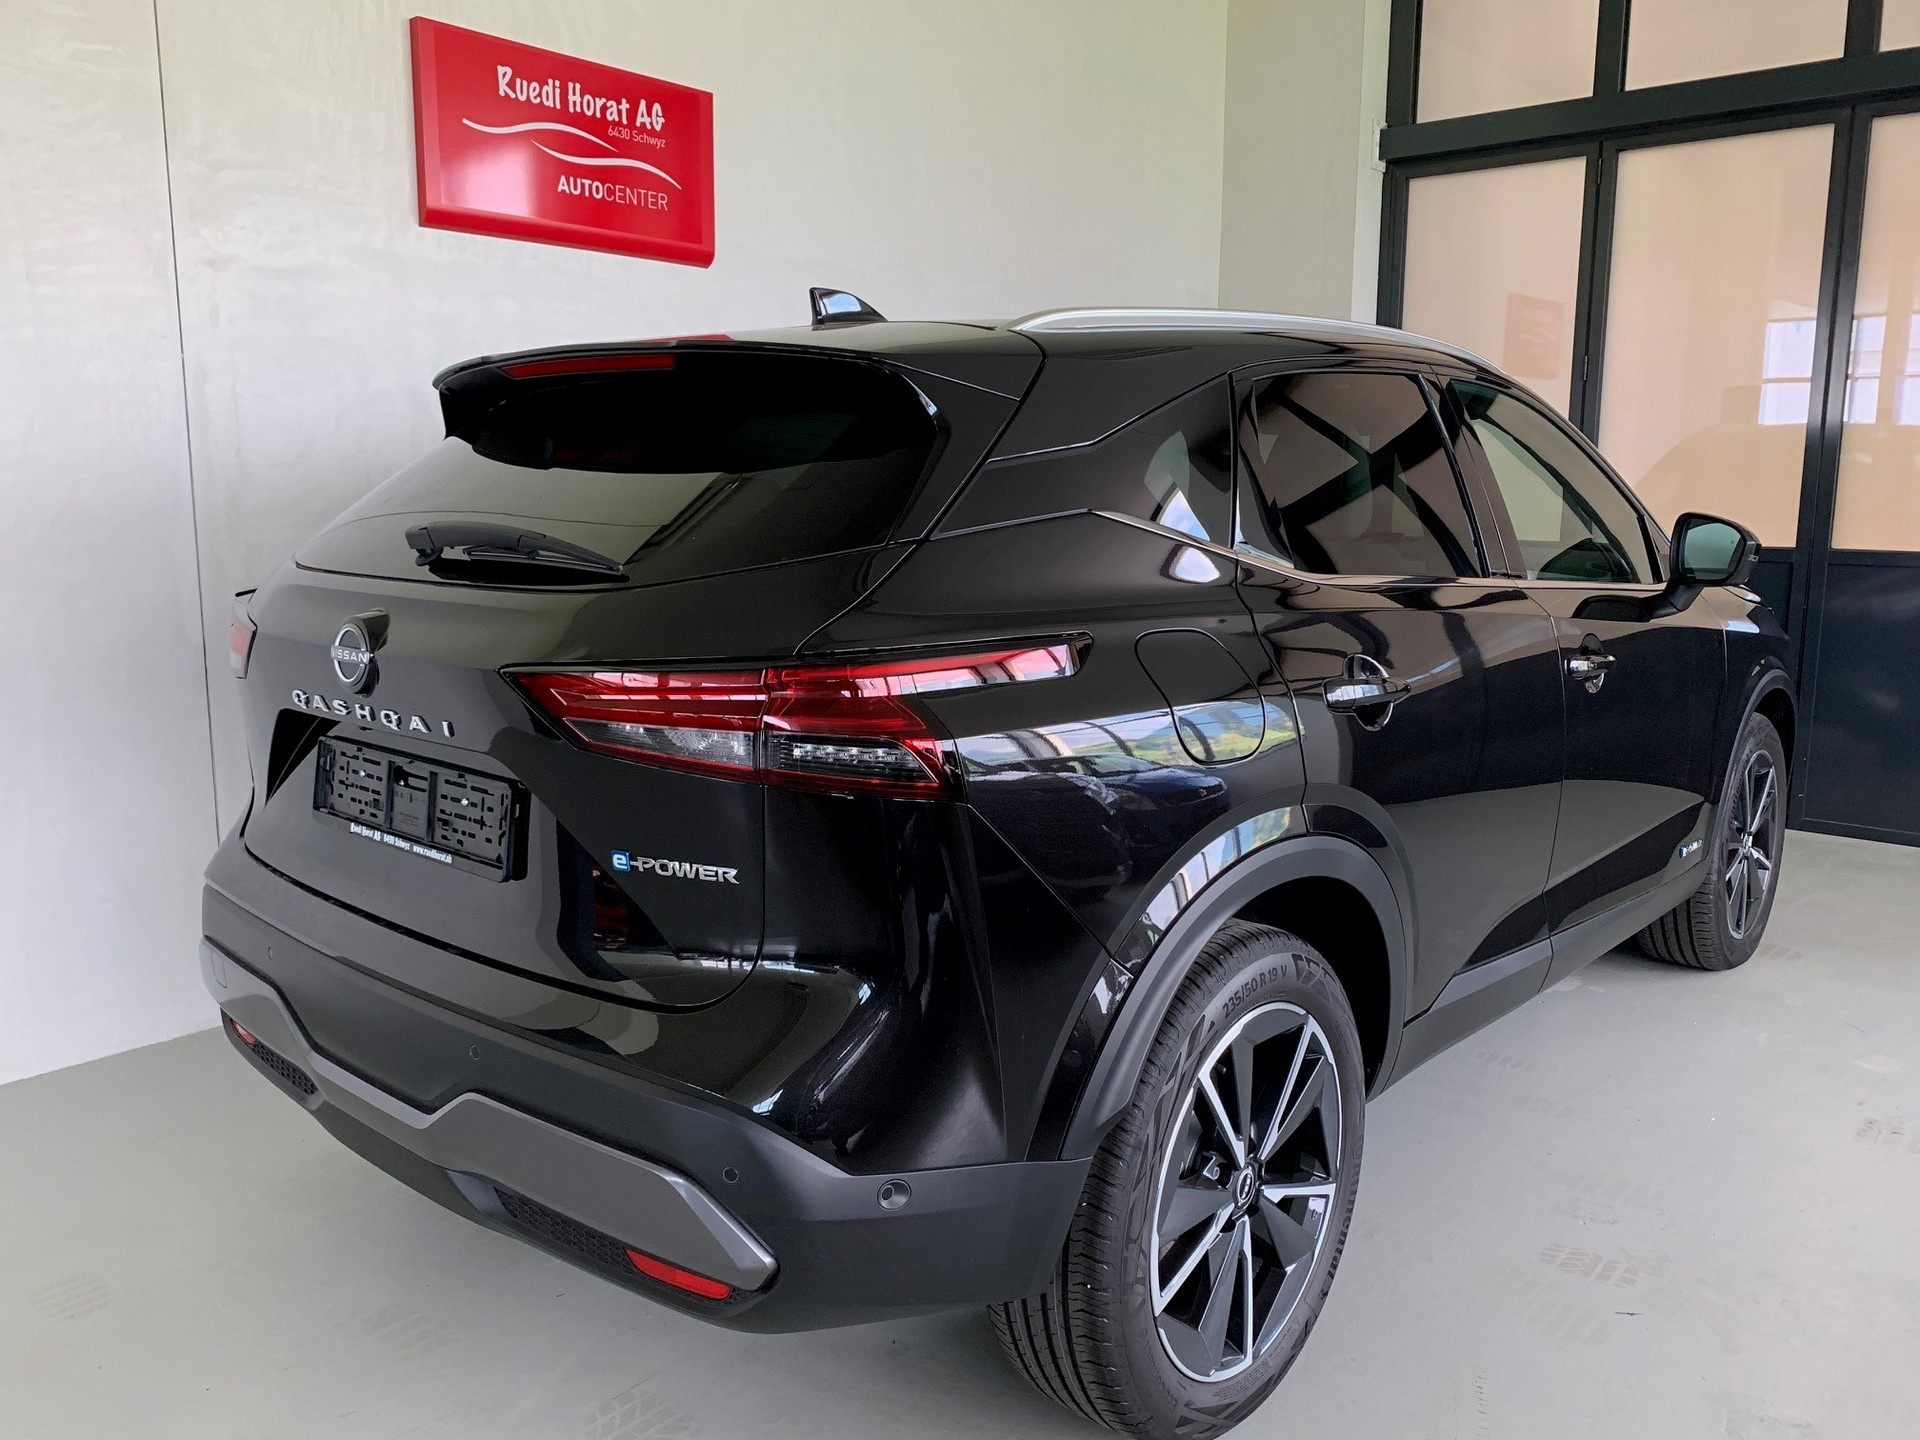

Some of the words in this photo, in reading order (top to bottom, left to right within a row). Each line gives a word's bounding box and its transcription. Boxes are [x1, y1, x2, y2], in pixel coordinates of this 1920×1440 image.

[497, 65, 561, 110] Ruedi
[568, 82, 630, 125] Horat
[636, 99, 666, 132] AG
[608, 125, 631, 140] 6430
[632, 130, 666, 148] Schwyz
[557, 175, 669, 212] AUTOCENTER
[331, 647, 368, 663] NISSAN
[292, 689, 455, 738] QASHQAI
[611, 852, 740, 885] e-POWER
[1223, 977, 1258, 1019] 235/50
